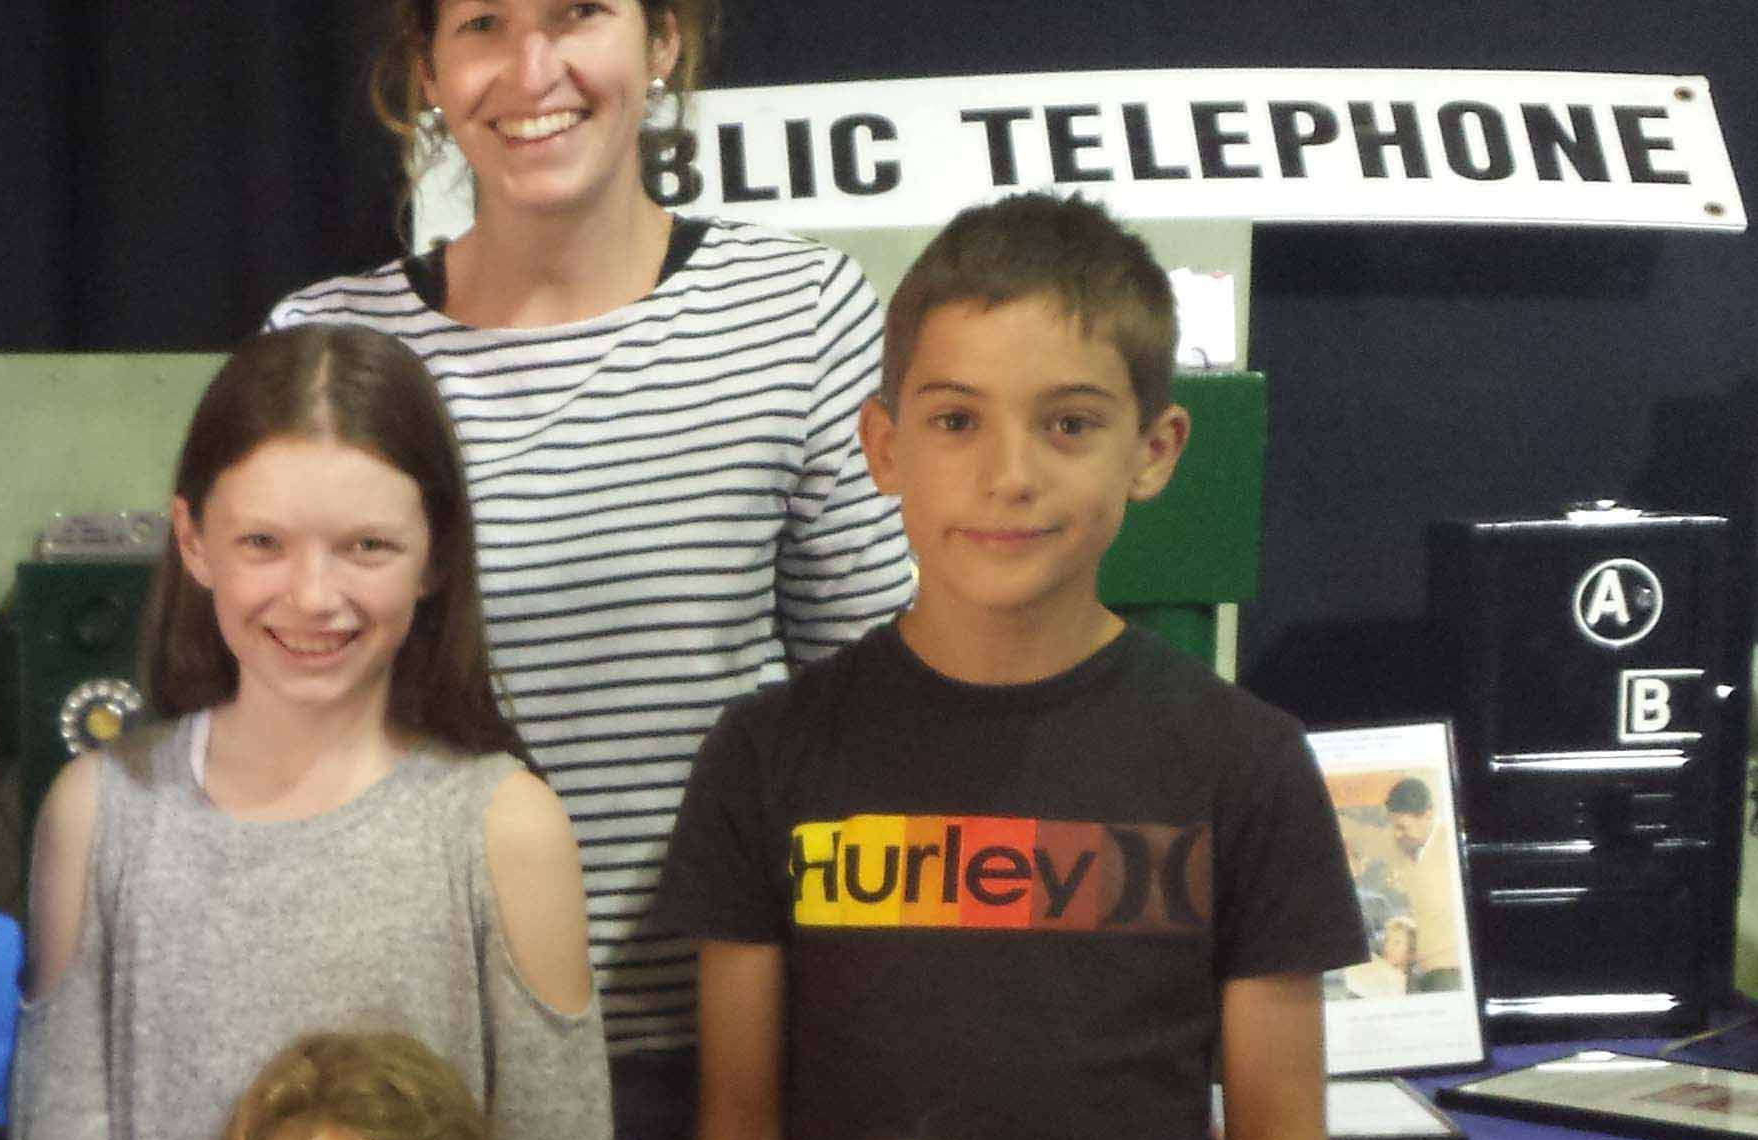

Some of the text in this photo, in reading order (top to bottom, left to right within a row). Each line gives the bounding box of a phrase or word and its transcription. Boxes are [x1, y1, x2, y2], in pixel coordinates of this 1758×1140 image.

[641, 99, 1694, 208] BLIC TELEPHONE
[1586, 568, 1631, 626] A
[1632, 677, 1672, 733] B
[789, 823, 1098, 919] Hurley
